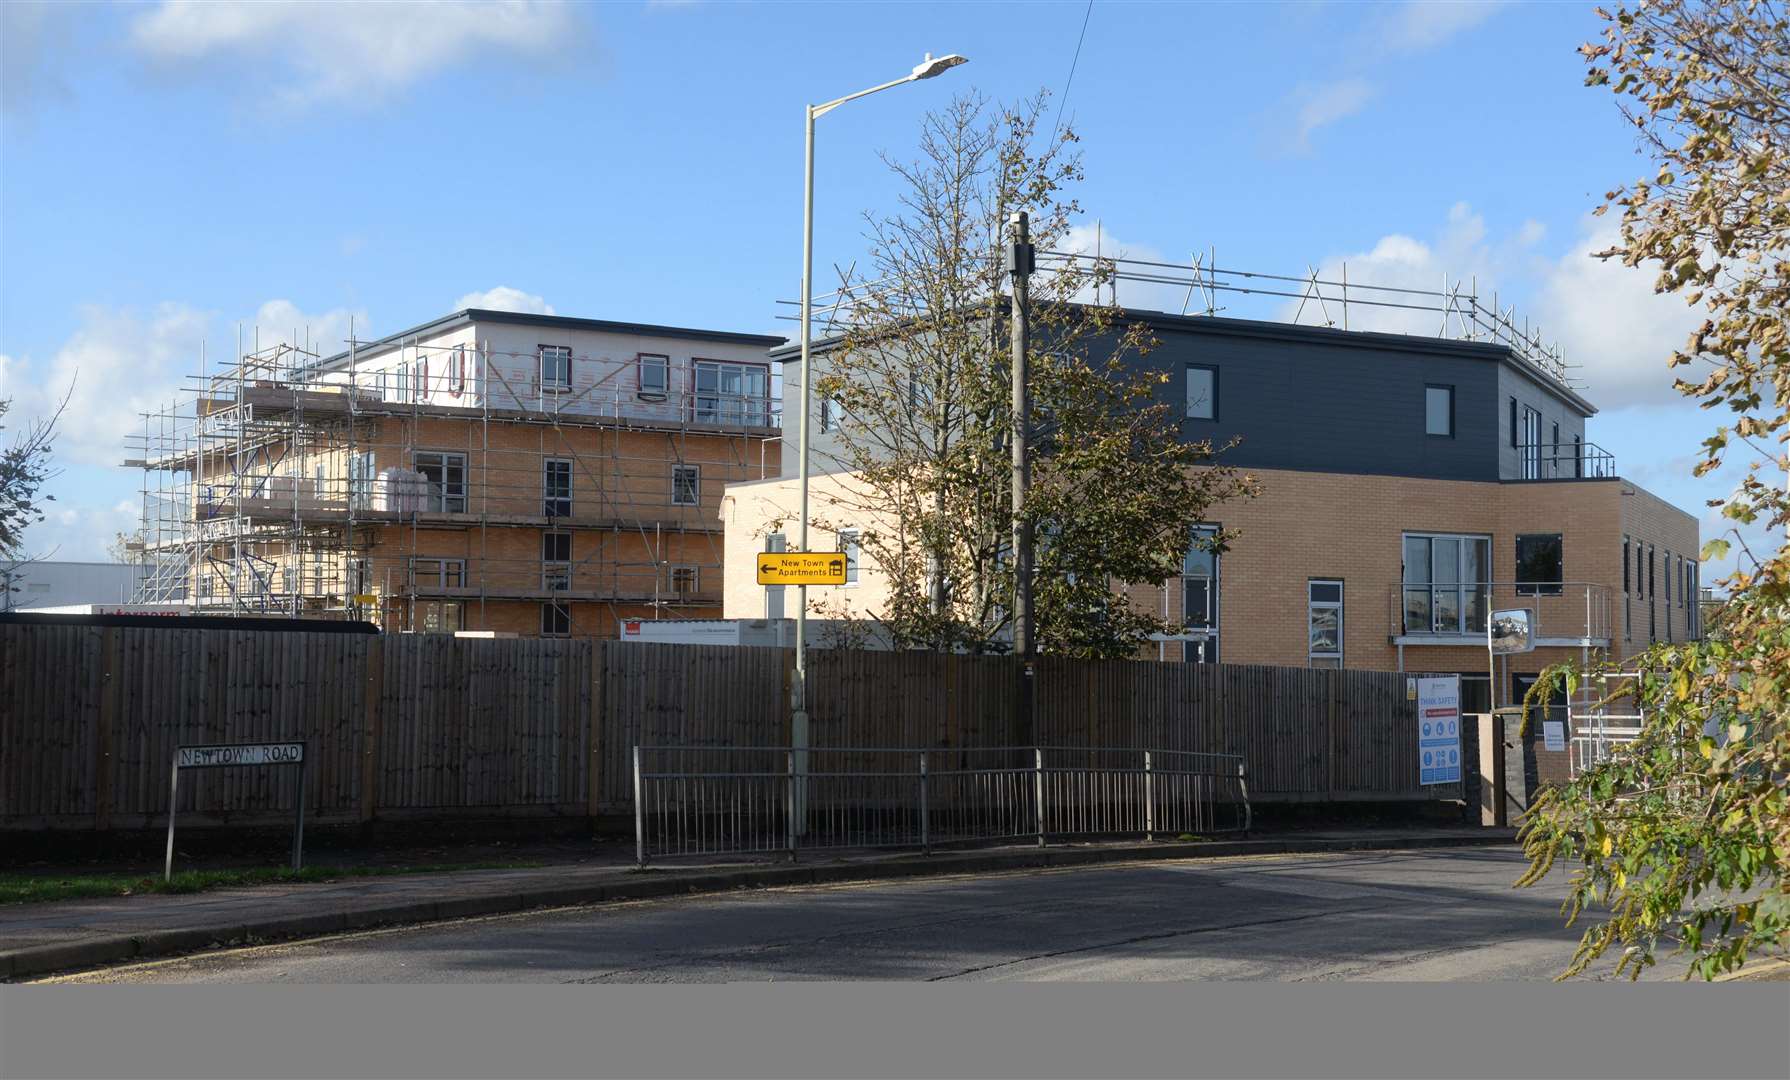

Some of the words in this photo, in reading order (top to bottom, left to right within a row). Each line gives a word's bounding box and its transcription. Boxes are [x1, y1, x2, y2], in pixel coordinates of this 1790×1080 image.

[781, 559, 800, 567] New
[803, 559, 824, 567] Town
[778, 568, 827, 577] Apartments
[181, 747, 256, 765] NEWTOWN
[263, 745, 299, 761] ROAD
